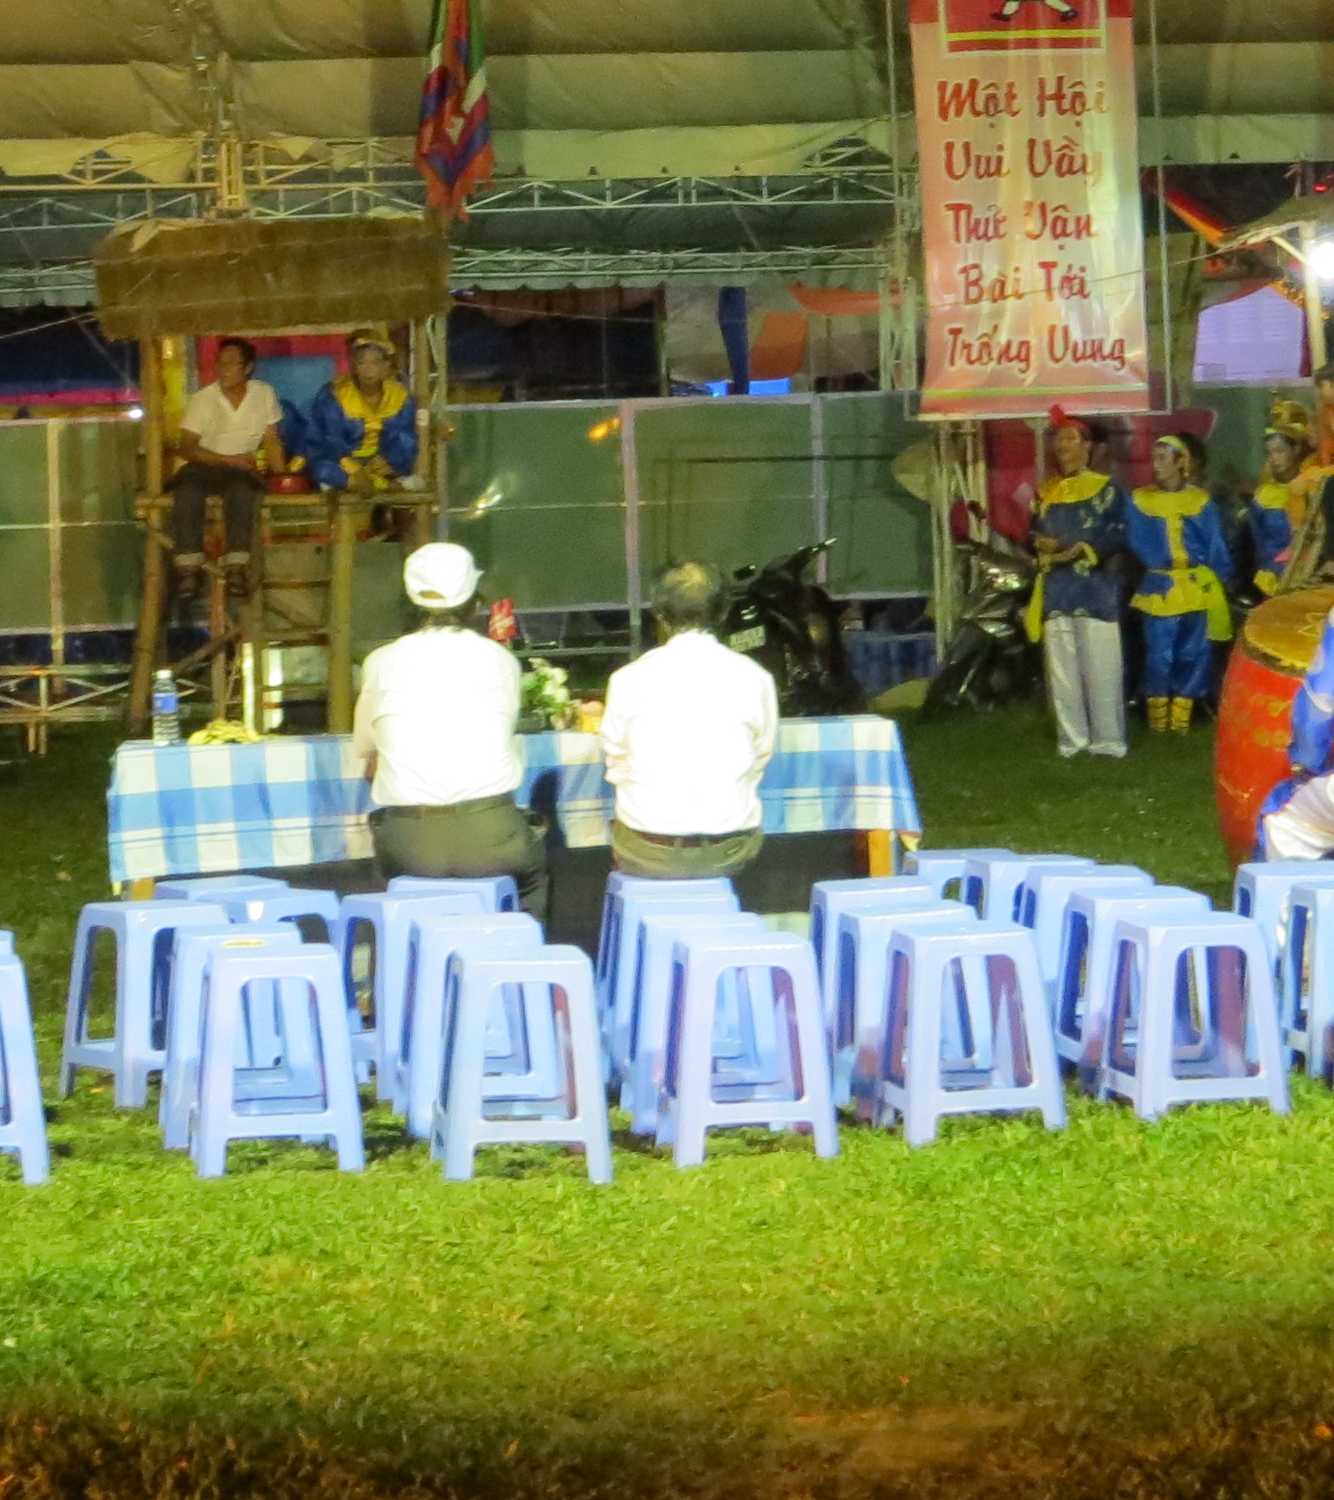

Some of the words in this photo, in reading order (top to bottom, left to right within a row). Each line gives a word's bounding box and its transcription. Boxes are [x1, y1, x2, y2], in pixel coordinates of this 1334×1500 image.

[937, 78, 1021, 129] Một
[1037, 75, 1110, 128] Hội
[958, 262, 1023, 305] Bài
[1038, 261, 1090, 302] Tới
